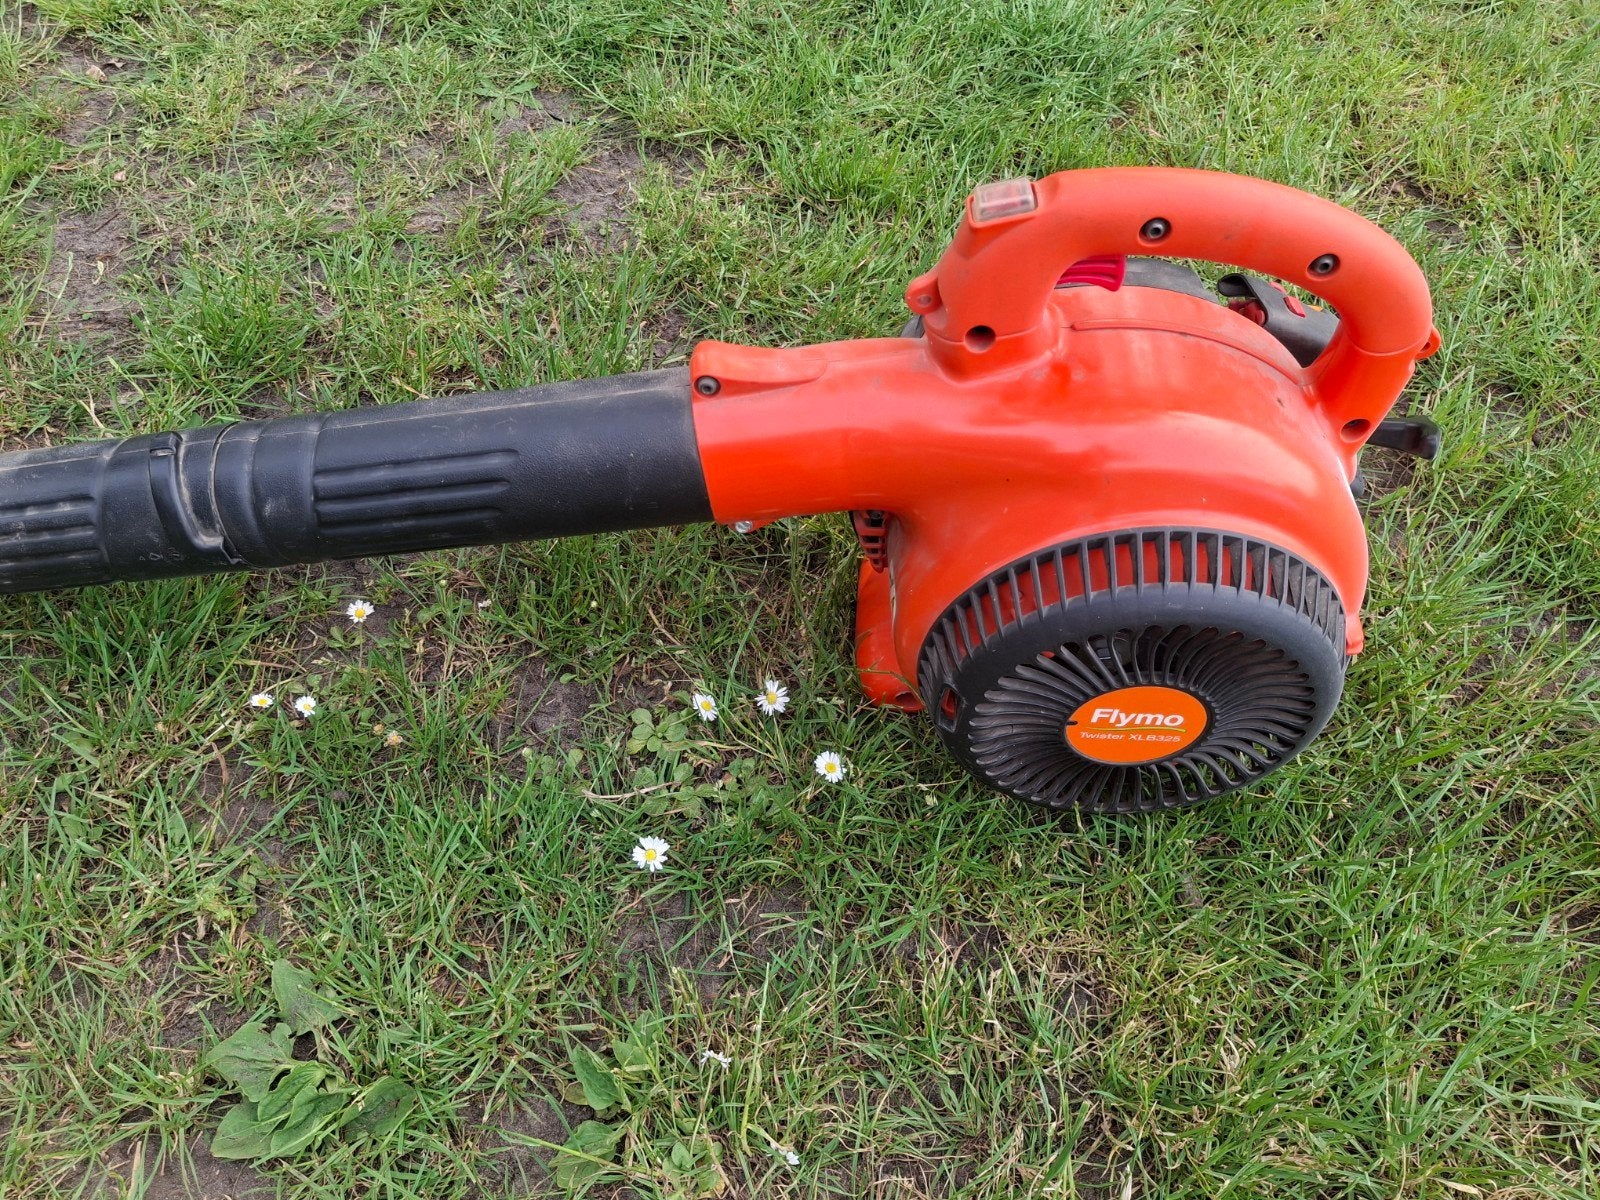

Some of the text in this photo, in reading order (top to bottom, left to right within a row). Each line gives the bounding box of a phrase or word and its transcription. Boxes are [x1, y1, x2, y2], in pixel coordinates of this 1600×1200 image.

[1091, 708, 1184, 727] Flymo
[1080, 731, 1181, 743] Twister XLB325
